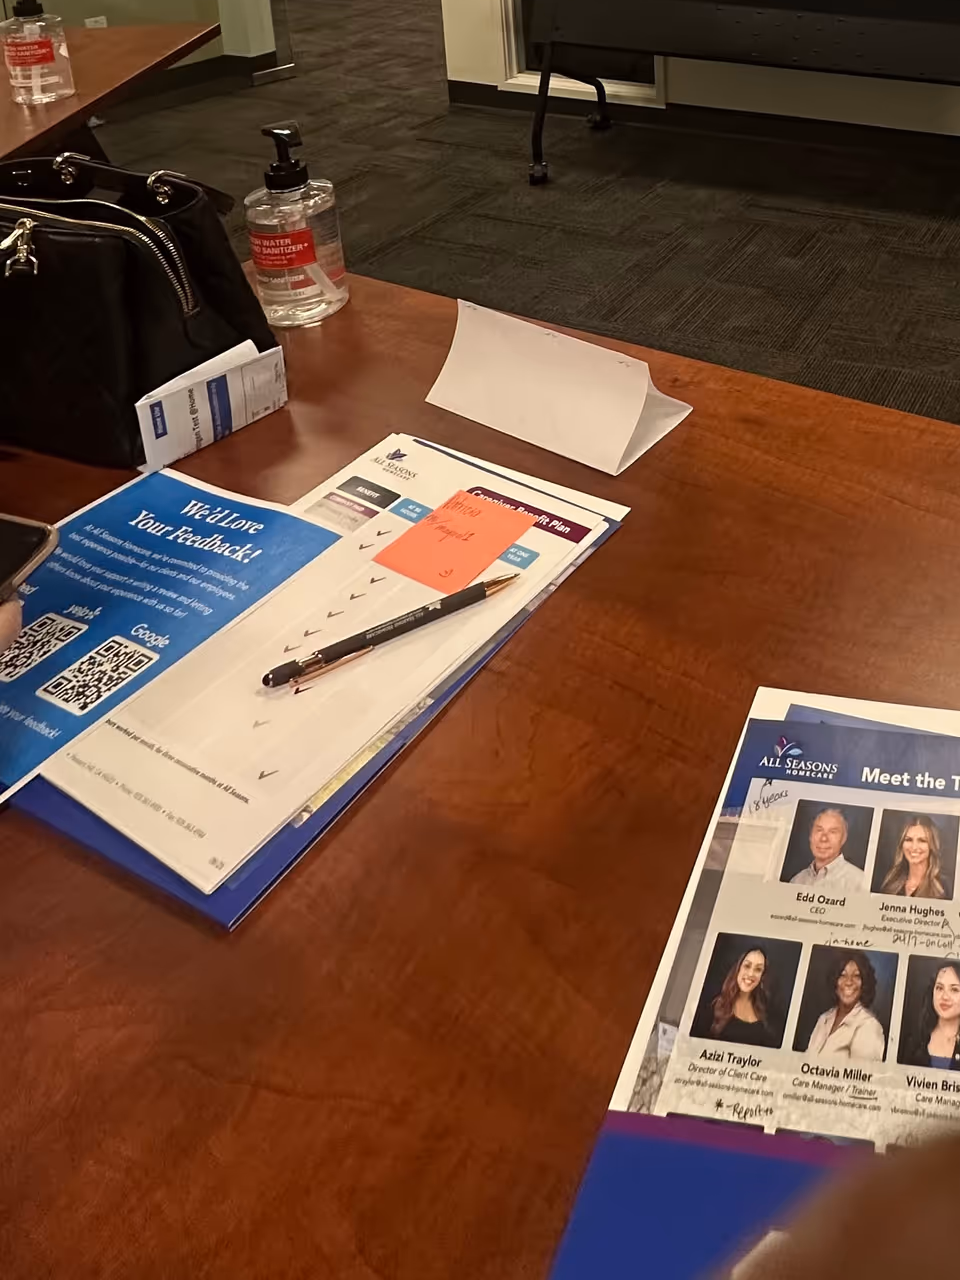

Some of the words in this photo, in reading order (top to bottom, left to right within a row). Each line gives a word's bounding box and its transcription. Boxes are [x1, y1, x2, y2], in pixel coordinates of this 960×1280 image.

[385, 461, 418, 478] SEASONS
[180, 500, 231, 524] We'd
[218, 513, 264, 534] Love
[548, 520, 571, 534] Plan
[128, 509, 173, 536] Your
[166, 526, 262, 563] Feedback!
[130, 623, 170, 648] Google
[759, 756, 782, 768] ALL
[785, 757, 838, 774] SEASONS
[861, 767, 910, 787] Meet
[915, 773, 946, 790] the
[786, 769, 833, 779] HOMECARE
[796, 892, 815, 903] Edd
[817, 895, 846, 906] Ozard
[809, 906, 825, 915] CEO
[879, 902, 907, 913] Jenna
[909, 905, 945, 917] Hughes
[881, 914, 912, 924] Executive
[914, 918, 941, 927] Director
[699, 1049, 725, 1062] Azizi
[727, 1052, 762, 1068] Traylor
[688, 1063, 717, 1075] Director
[719, 1067, 727, 1077] of
[728, 1068, 748, 1080] Client
[750, 1072, 767, 1082] Care
[801, 1063, 840, 1079] Octavia
[843, 1070, 873, 1083] Miller
[792, 1077, 810, 1088] Care
[811, 1081, 845, 1095] Manager
[852, 1086, 876, 1096] Trainer
[906, 1076, 938, 1090] Vivien
[915, 1093, 934, 1104] Care
